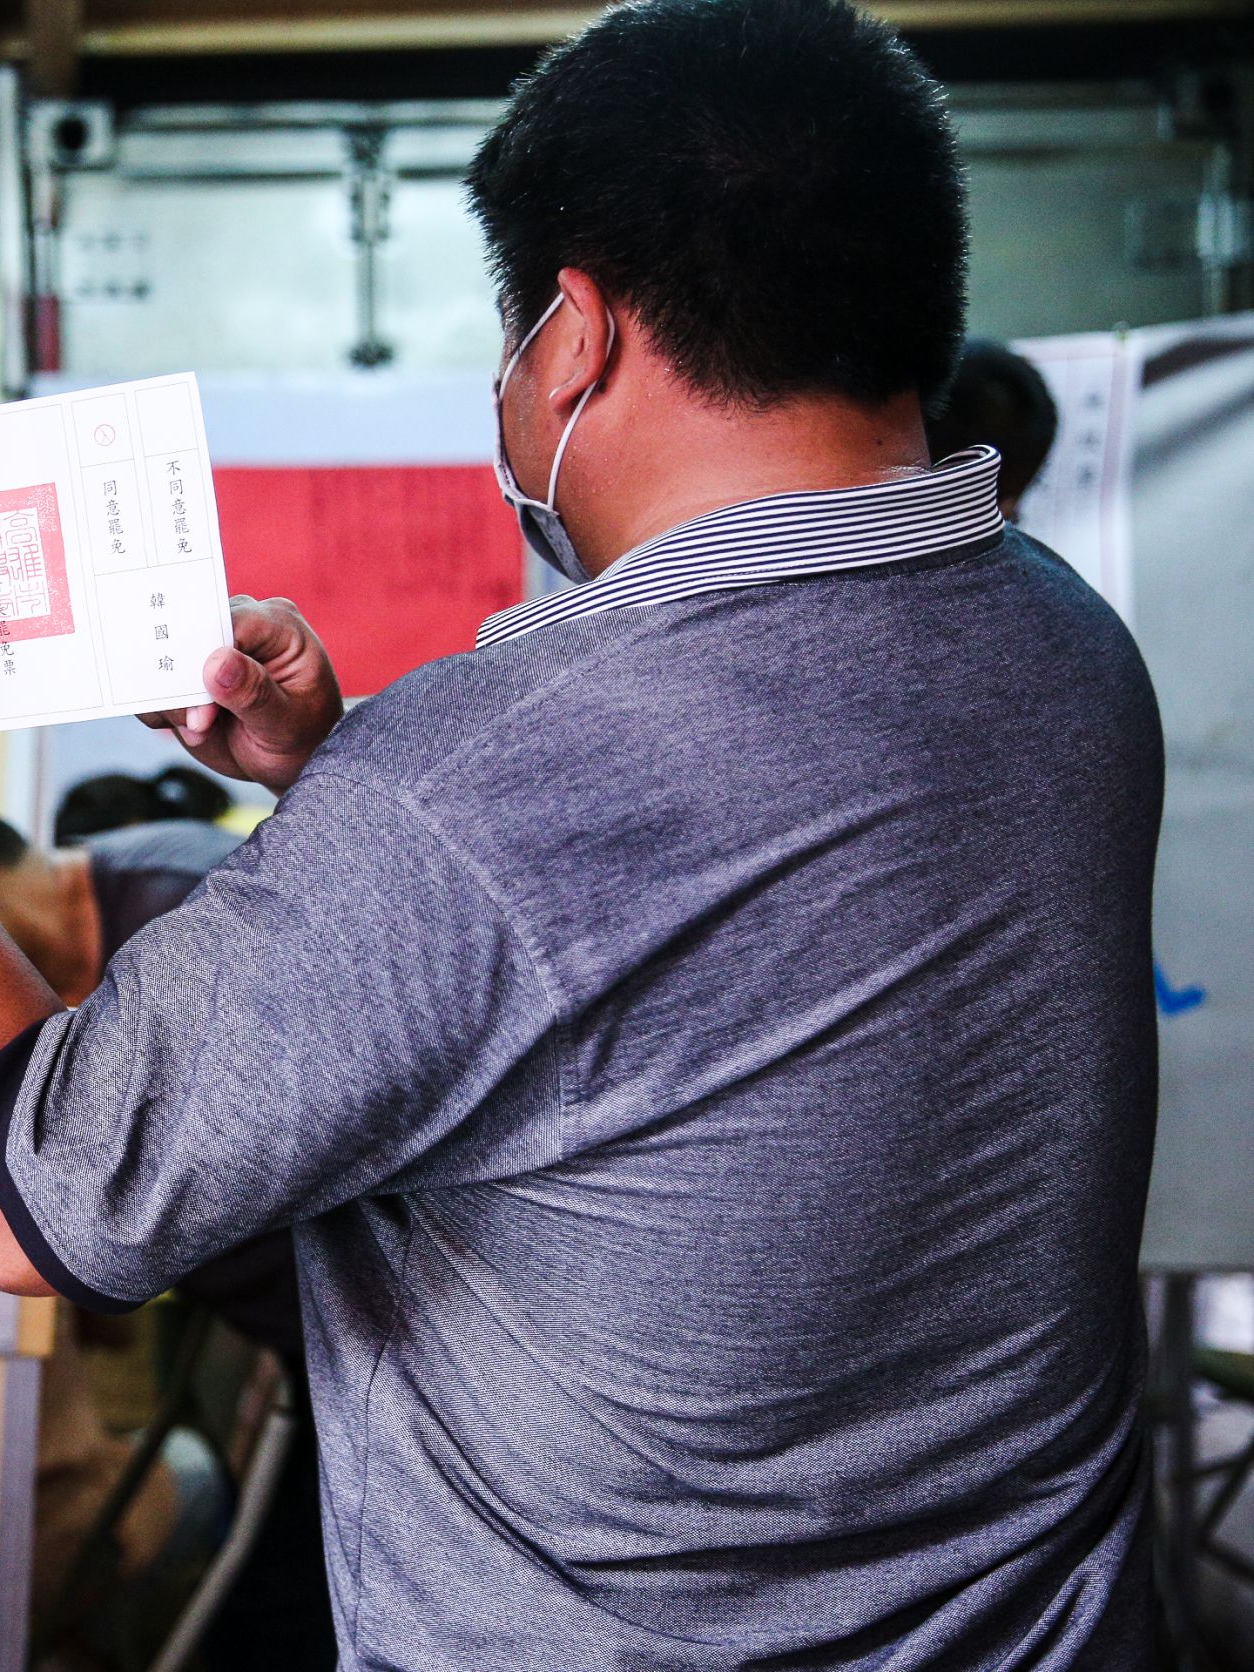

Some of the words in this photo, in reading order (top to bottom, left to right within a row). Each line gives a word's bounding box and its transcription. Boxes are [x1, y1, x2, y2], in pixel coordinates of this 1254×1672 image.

[102, 479, 126, 555] 同意罷免
[166, 459, 193, 555] 不同意罷免
[149, 592, 175, 673] 韓國瑜
